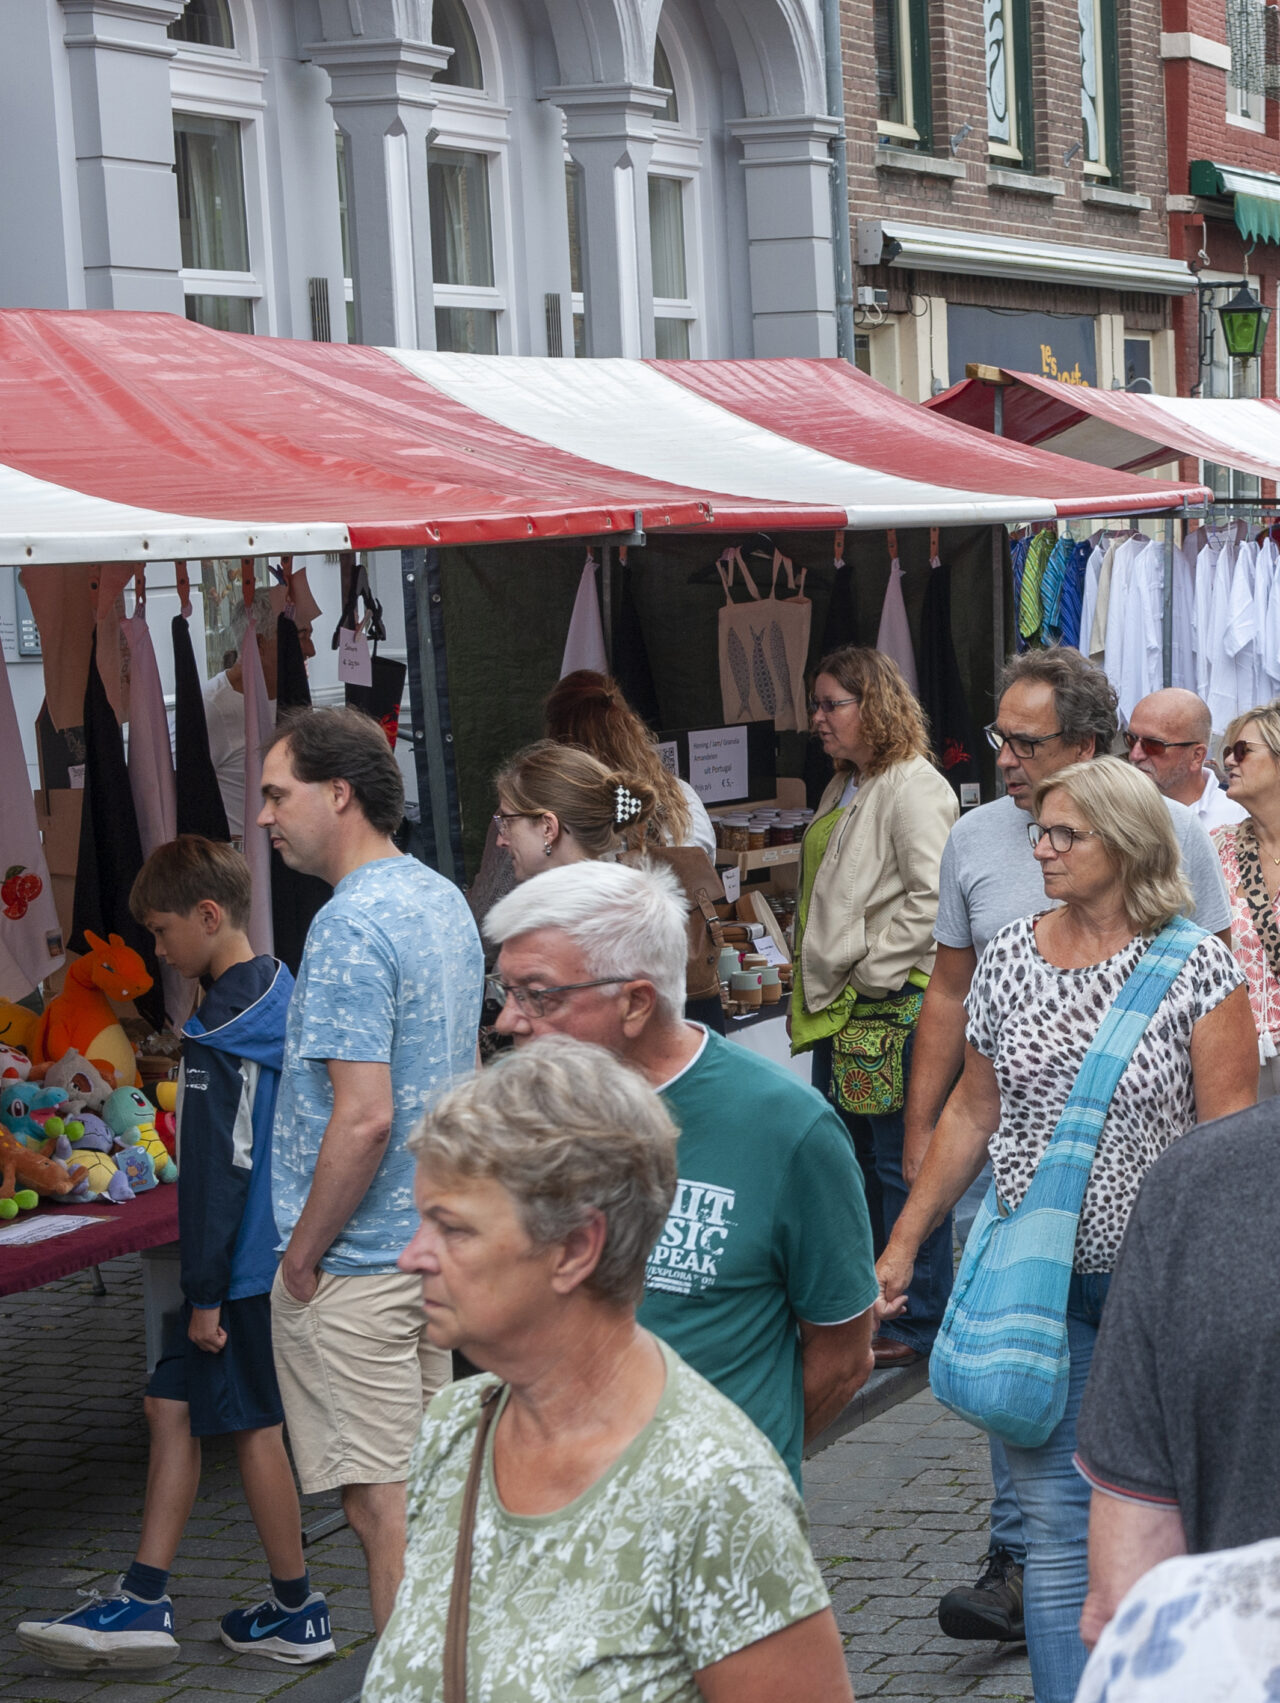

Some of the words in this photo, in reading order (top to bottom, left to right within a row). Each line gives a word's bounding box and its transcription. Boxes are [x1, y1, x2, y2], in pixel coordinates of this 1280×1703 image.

[712, 763, 733, 774] Portugal
[647, 1245, 718, 1276] PEAK
[164, 1612, 171, 1629] A
